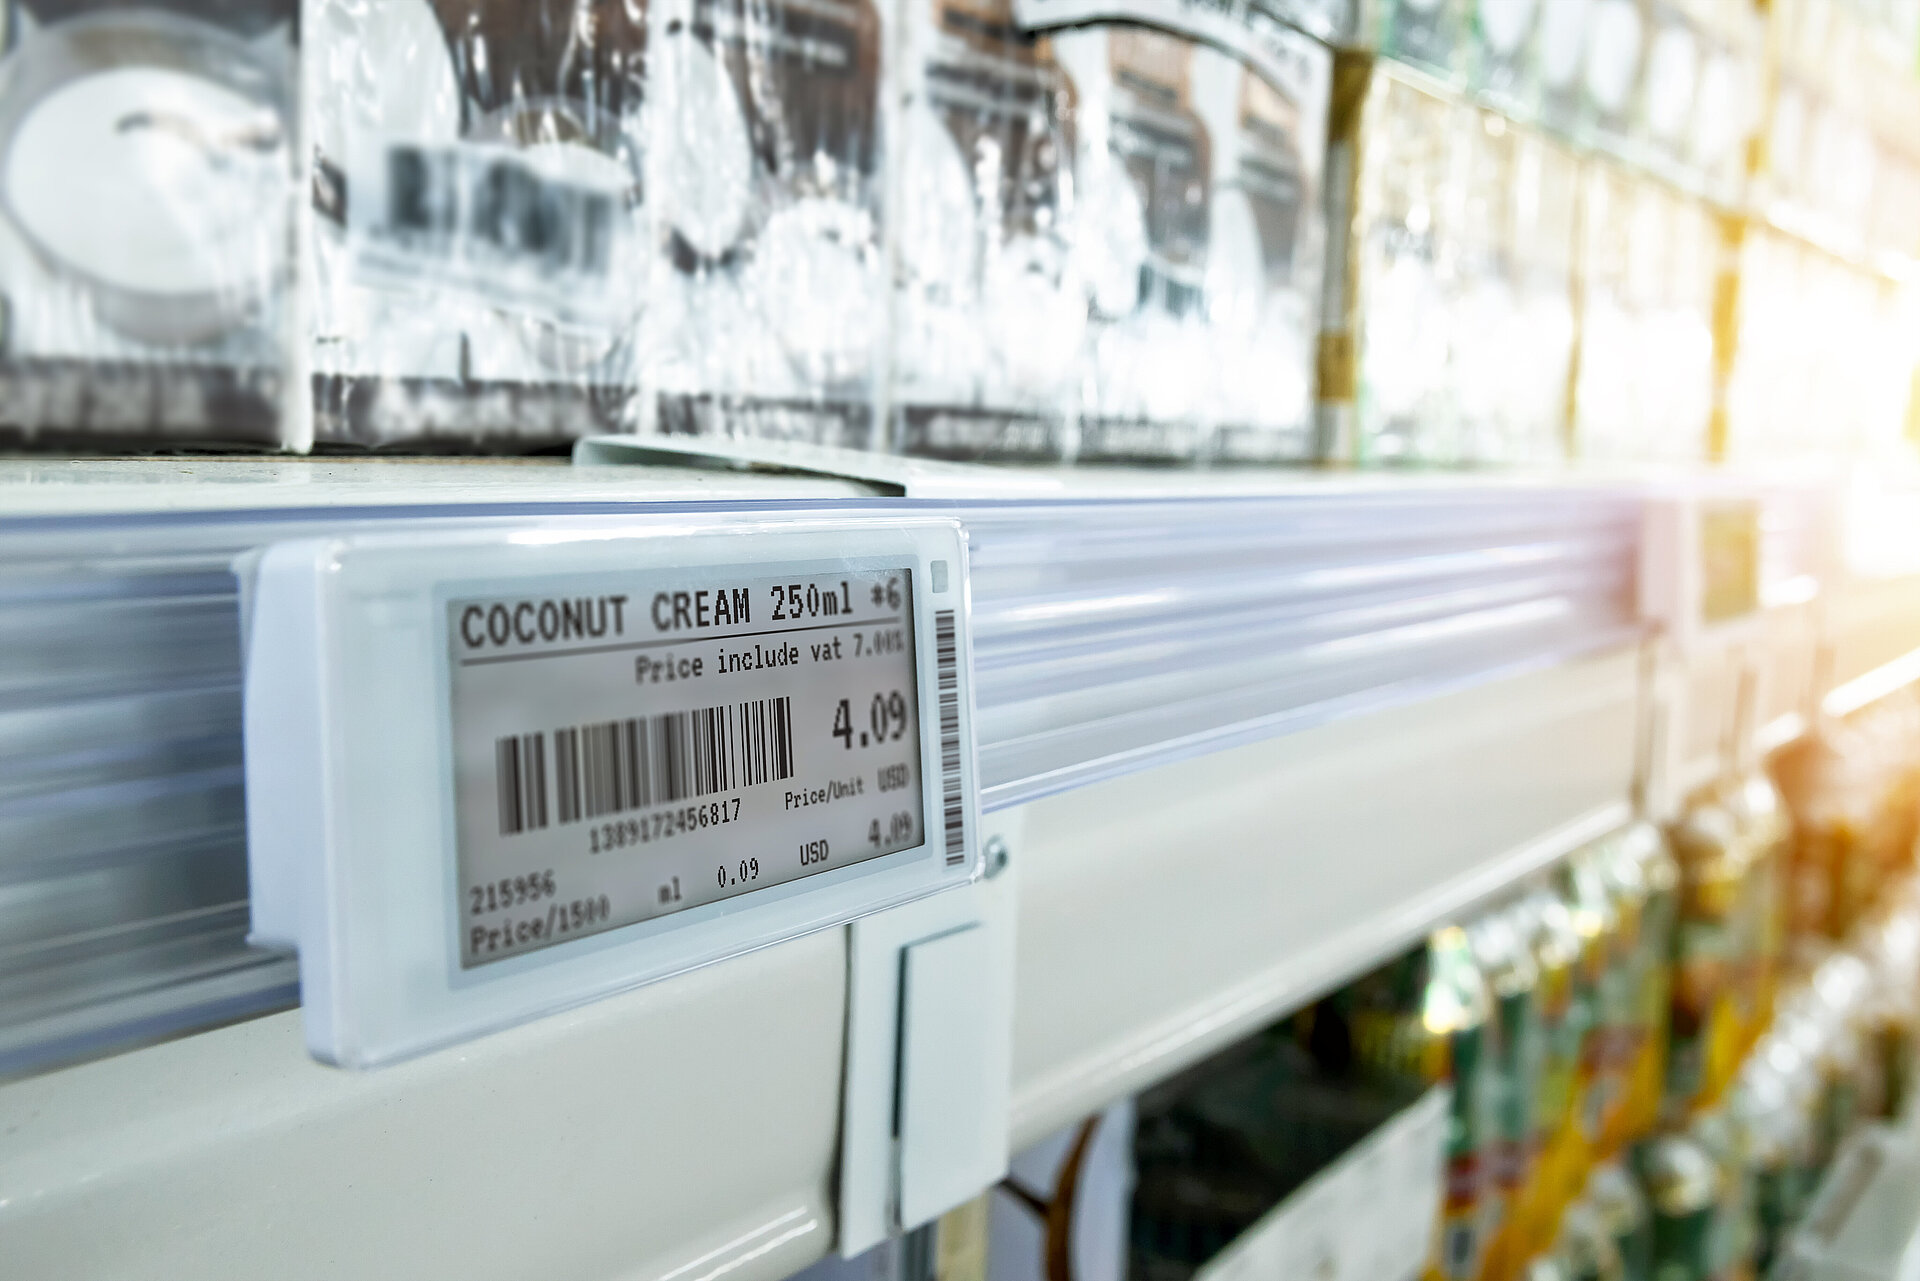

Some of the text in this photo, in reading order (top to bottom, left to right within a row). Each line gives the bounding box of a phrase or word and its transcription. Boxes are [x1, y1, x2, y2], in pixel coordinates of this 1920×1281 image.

[461, 597, 627, 648] COCONUT
[652, 588, 751, 632] CREAM
[771, 581, 853, 621] 250ml
[636, 655, 704, 684] Price
[718, 645, 799, 674] include
[811, 636, 842, 662] vat
[832, 692, 908, 750] 4.09
[785, 762, 910, 811] Price/Unit USD
[868, 811, 913, 848] 4.09
[658, 877, 682, 904] ml
[717, 858, 760, 888] 0.09
[800, 839, 829, 866] USD
